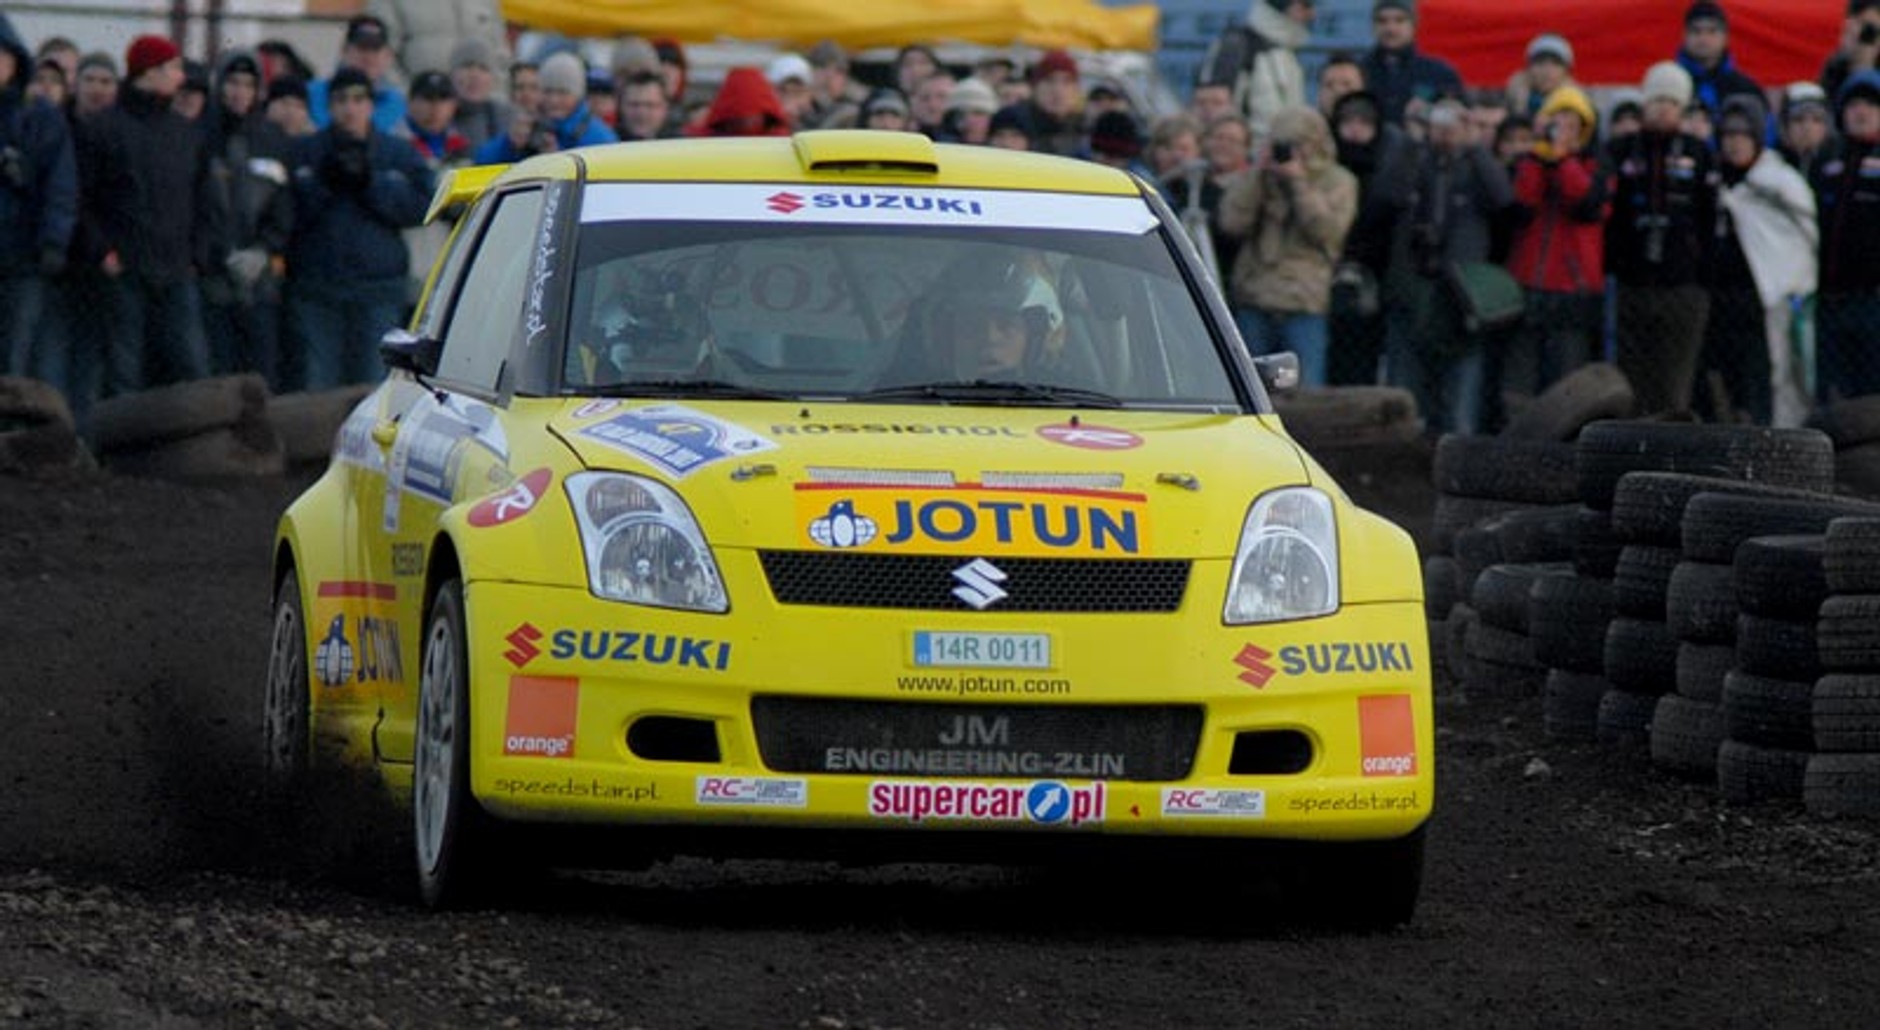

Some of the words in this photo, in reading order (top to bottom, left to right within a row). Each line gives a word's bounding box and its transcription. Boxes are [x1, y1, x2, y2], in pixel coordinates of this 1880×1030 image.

[812, 193, 982, 216] SUZUKI
[771, 423, 1029, 440] ROSSIGNOL
[886, 500, 1139, 553] JOTUN
[550, 629, 731, 671] SUZUKI
[935, 637, 980, 659] 14R
[987, 638, 1042, 662] 0011
[1278, 642, 1413, 676] SUZUKI
[897, 674, 1071, 695] www.jotun.com
[938, 715, 1009, 745] JM
[507, 736, 568, 756] orange
[825, 747, 1125, 776] ENGINEERING-ZLIN
[1363, 756, 1412, 774] orange
[494, 778, 661, 802] speedstar.pl
[1289, 791, 1420, 815] speedstar.pl
